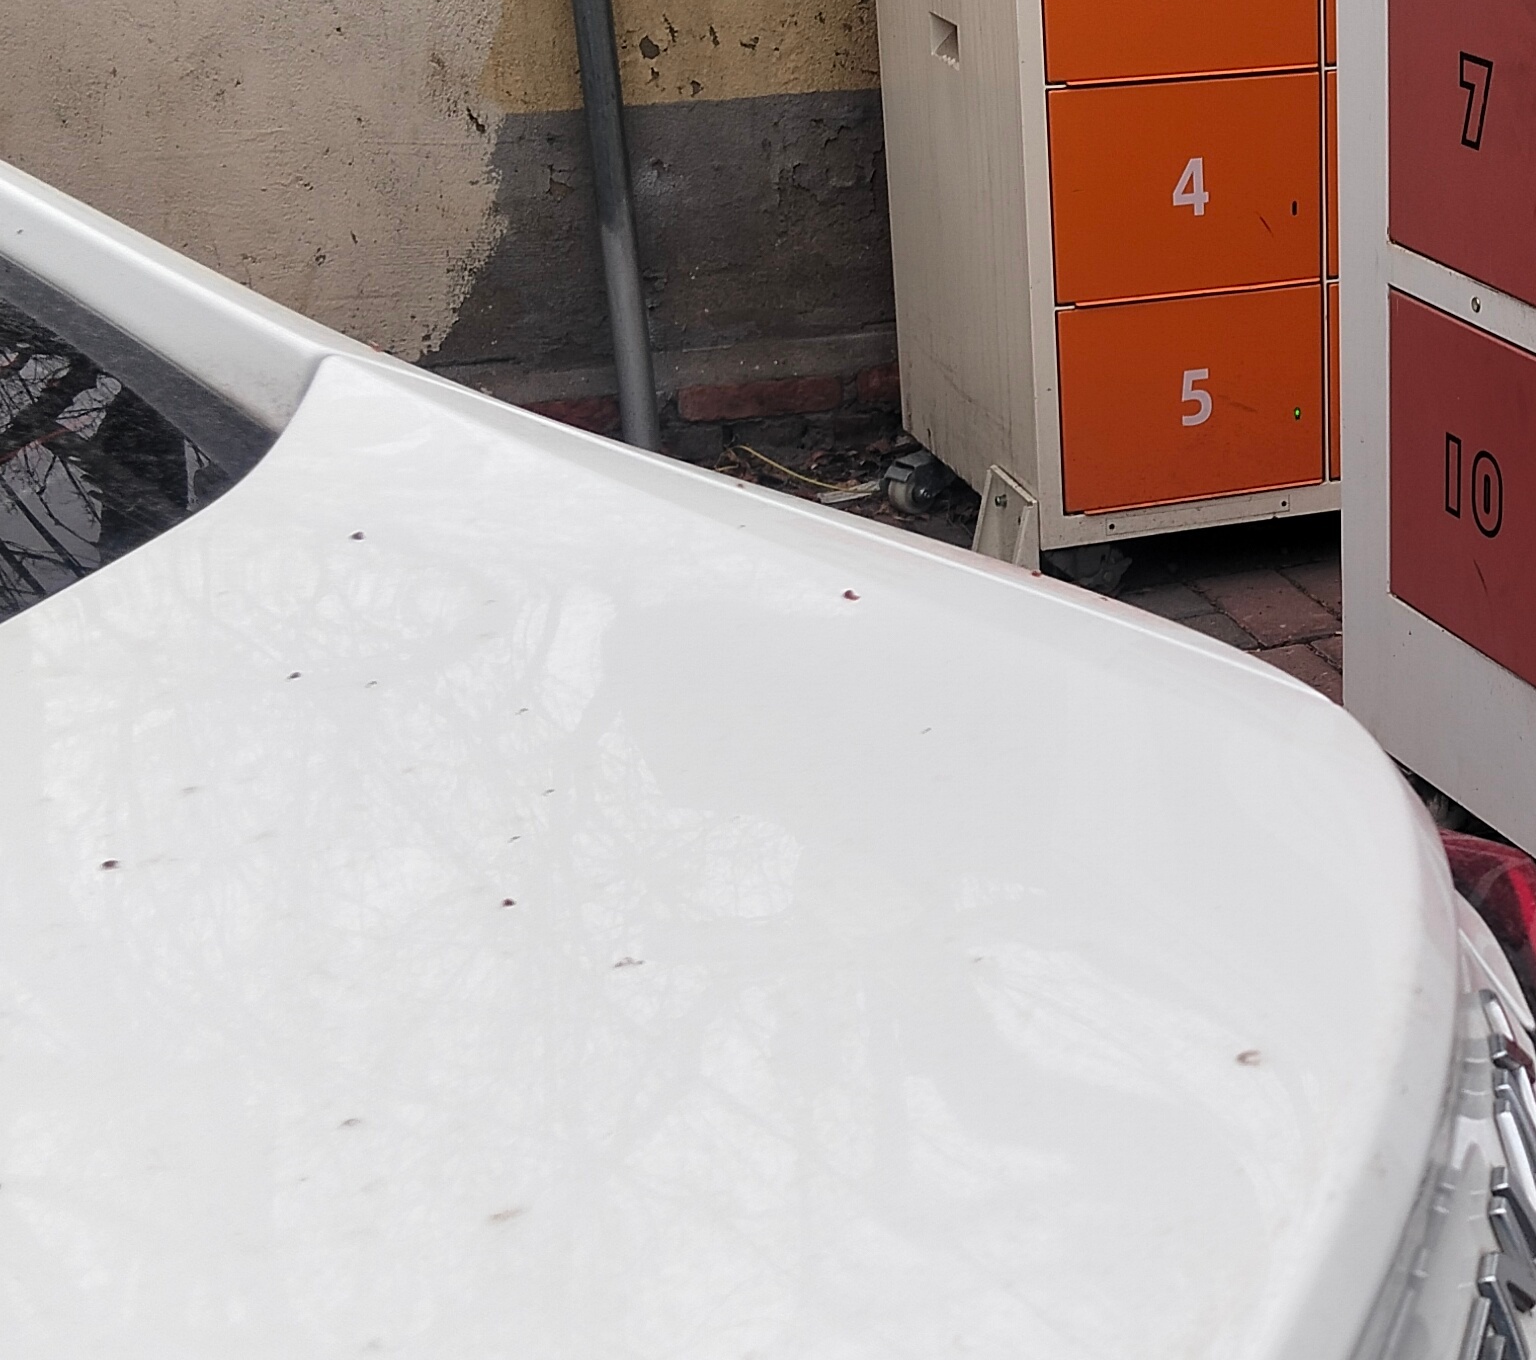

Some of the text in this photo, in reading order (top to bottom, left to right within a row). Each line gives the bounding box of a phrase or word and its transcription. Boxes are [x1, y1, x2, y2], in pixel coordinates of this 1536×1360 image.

[1459, 51, 1493, 150] 7
[1172, 157, 1209, 216] 4
[1181, 368, 1213, 426] 5
[1446, 432, 1503, 538] 10
